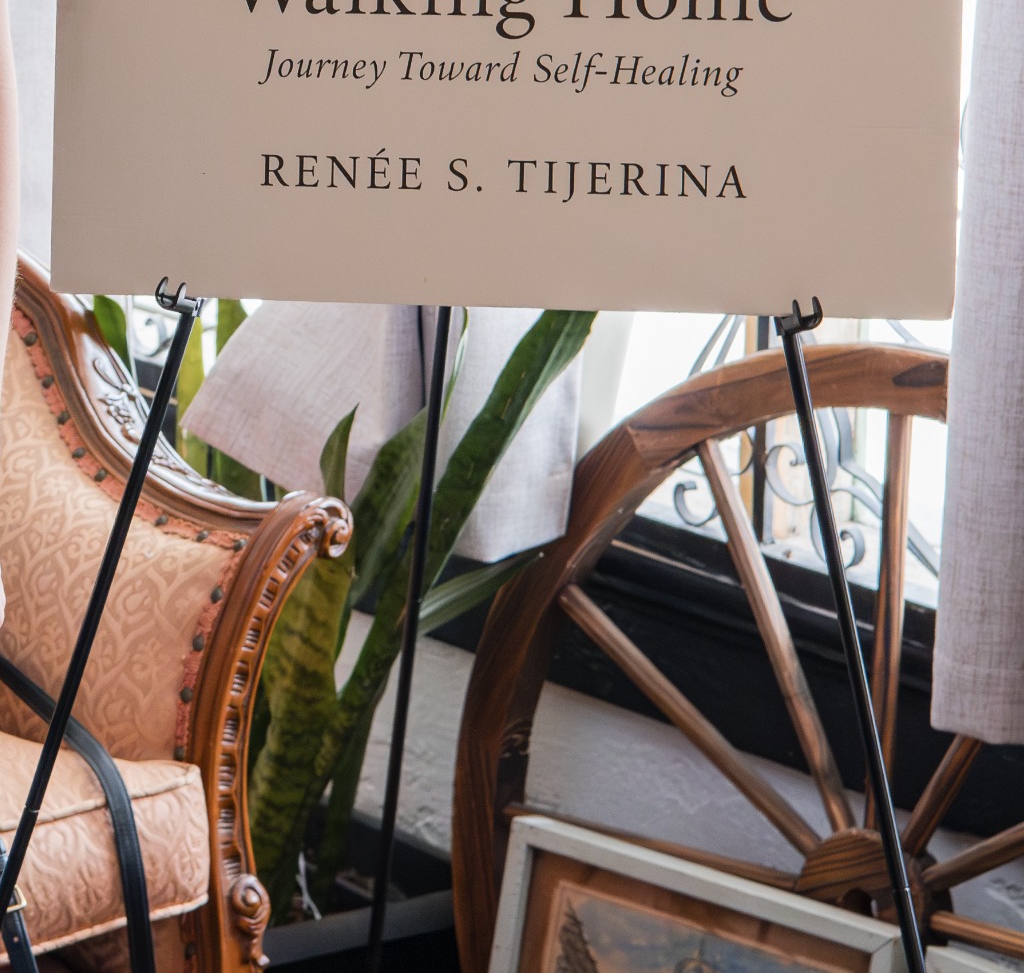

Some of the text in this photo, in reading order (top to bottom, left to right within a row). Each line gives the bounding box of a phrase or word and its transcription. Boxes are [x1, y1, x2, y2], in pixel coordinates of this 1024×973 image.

[258, 49, 743, 97] Journey Toward Self-Healing
[261, 148, 746, 203] RENÉE S. TIJERINA
